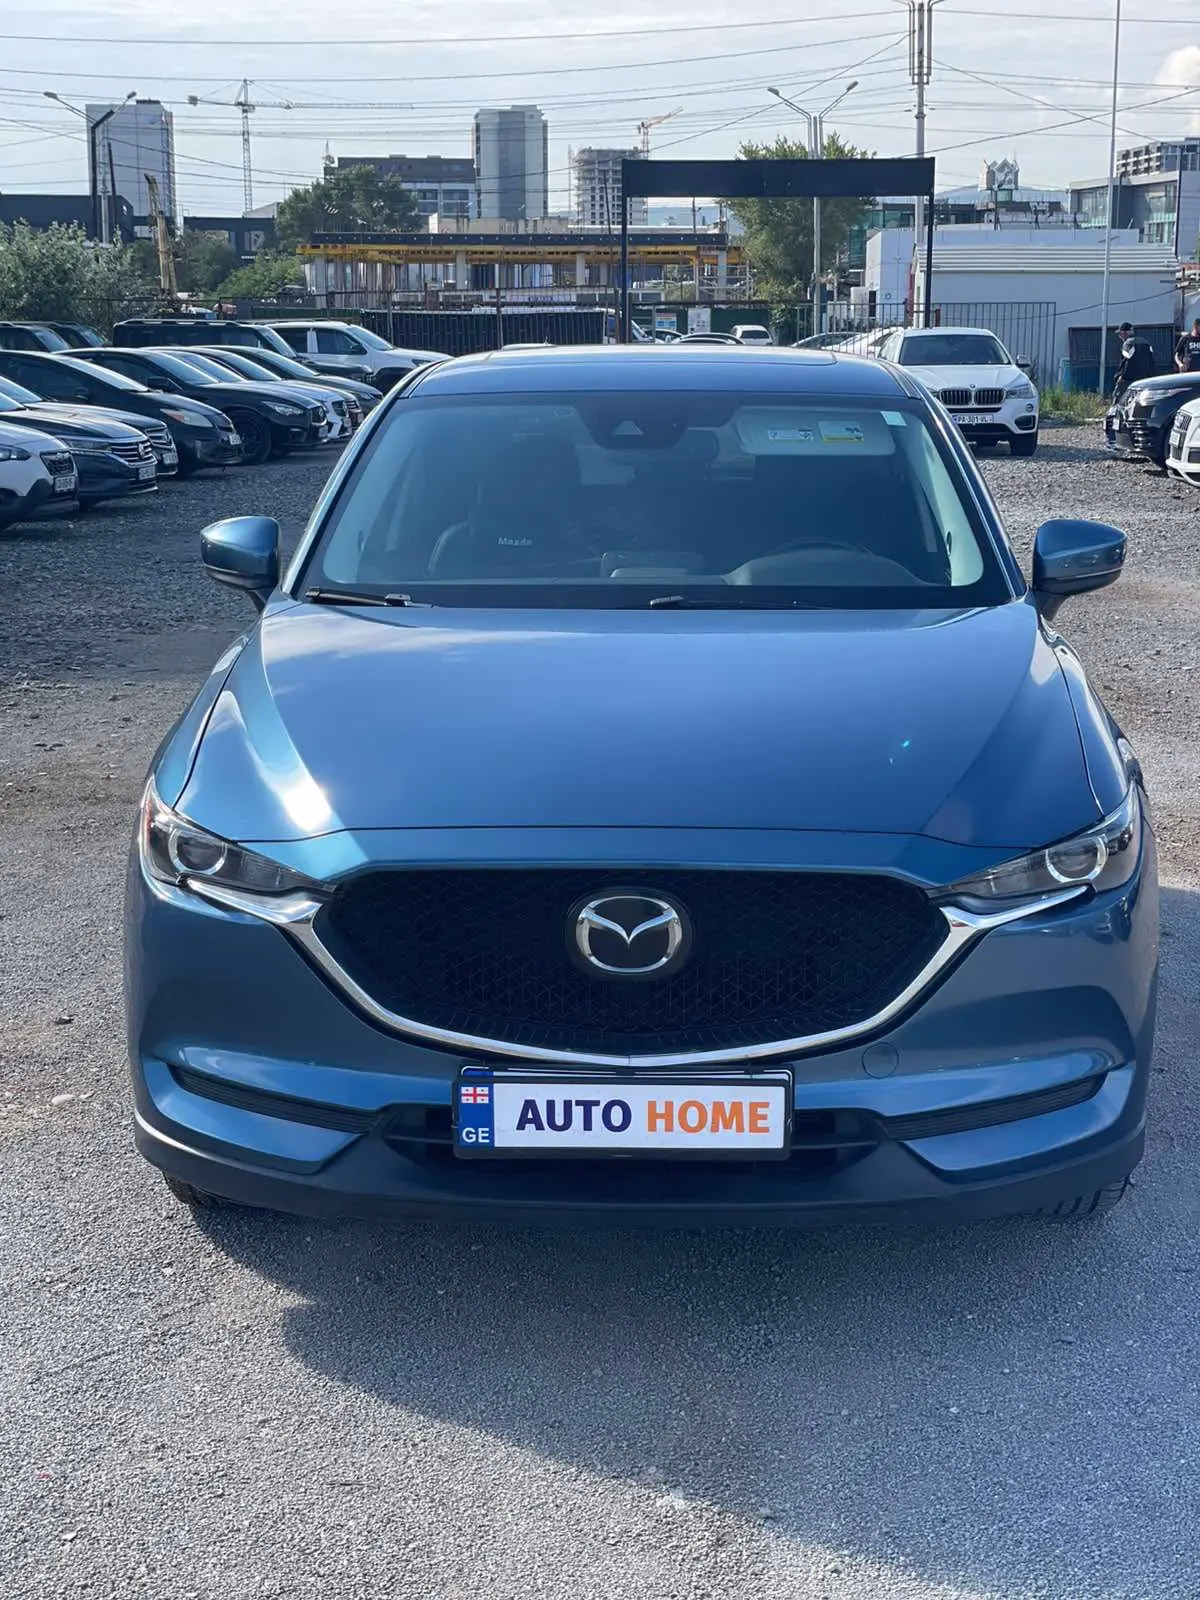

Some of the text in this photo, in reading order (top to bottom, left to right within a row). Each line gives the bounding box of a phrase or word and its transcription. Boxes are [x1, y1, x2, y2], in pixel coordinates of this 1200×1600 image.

[516, 1099, 770, 1133] AUTO HOME
[461, 1127, 490, 1144] GE
